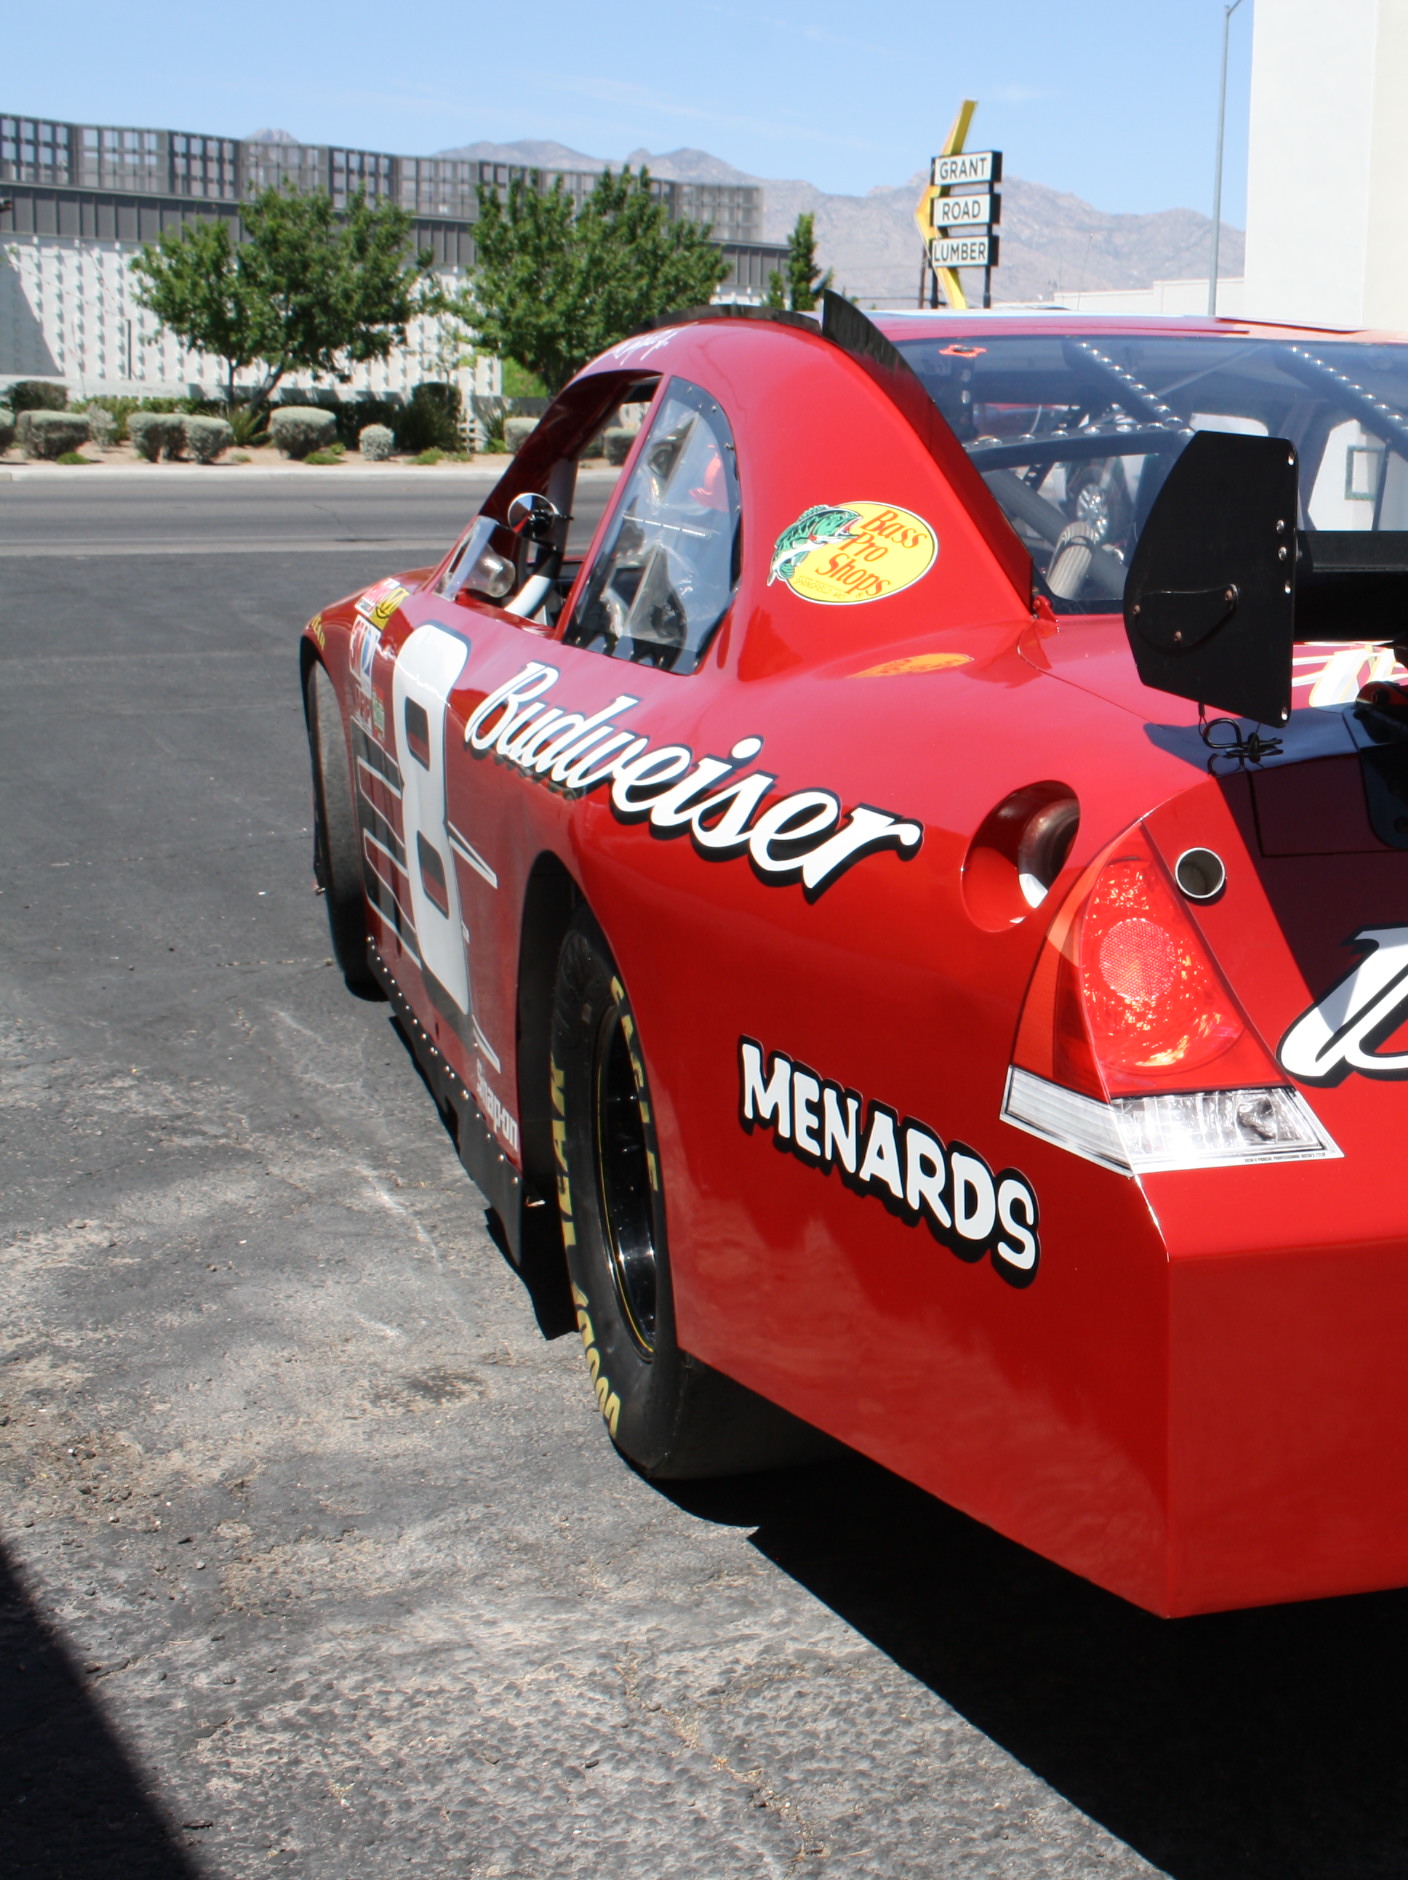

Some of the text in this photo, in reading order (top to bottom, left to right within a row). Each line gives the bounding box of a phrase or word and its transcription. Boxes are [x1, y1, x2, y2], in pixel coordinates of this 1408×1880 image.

[939, 157, 988, 180] GRANT
[941, 199, 982, 220] ROAD
[933, 241, 987, 262] LUMBER
[838, 531, 888, 562] Pro
[860, 509, 927, 549] Bass
[815, 552, 891, 597] Shops
[464, 660, 923, 902] Budweiser
[391, 621, 470, 1016] 8
[738, 1034, 1040, 1288] MENARDS
